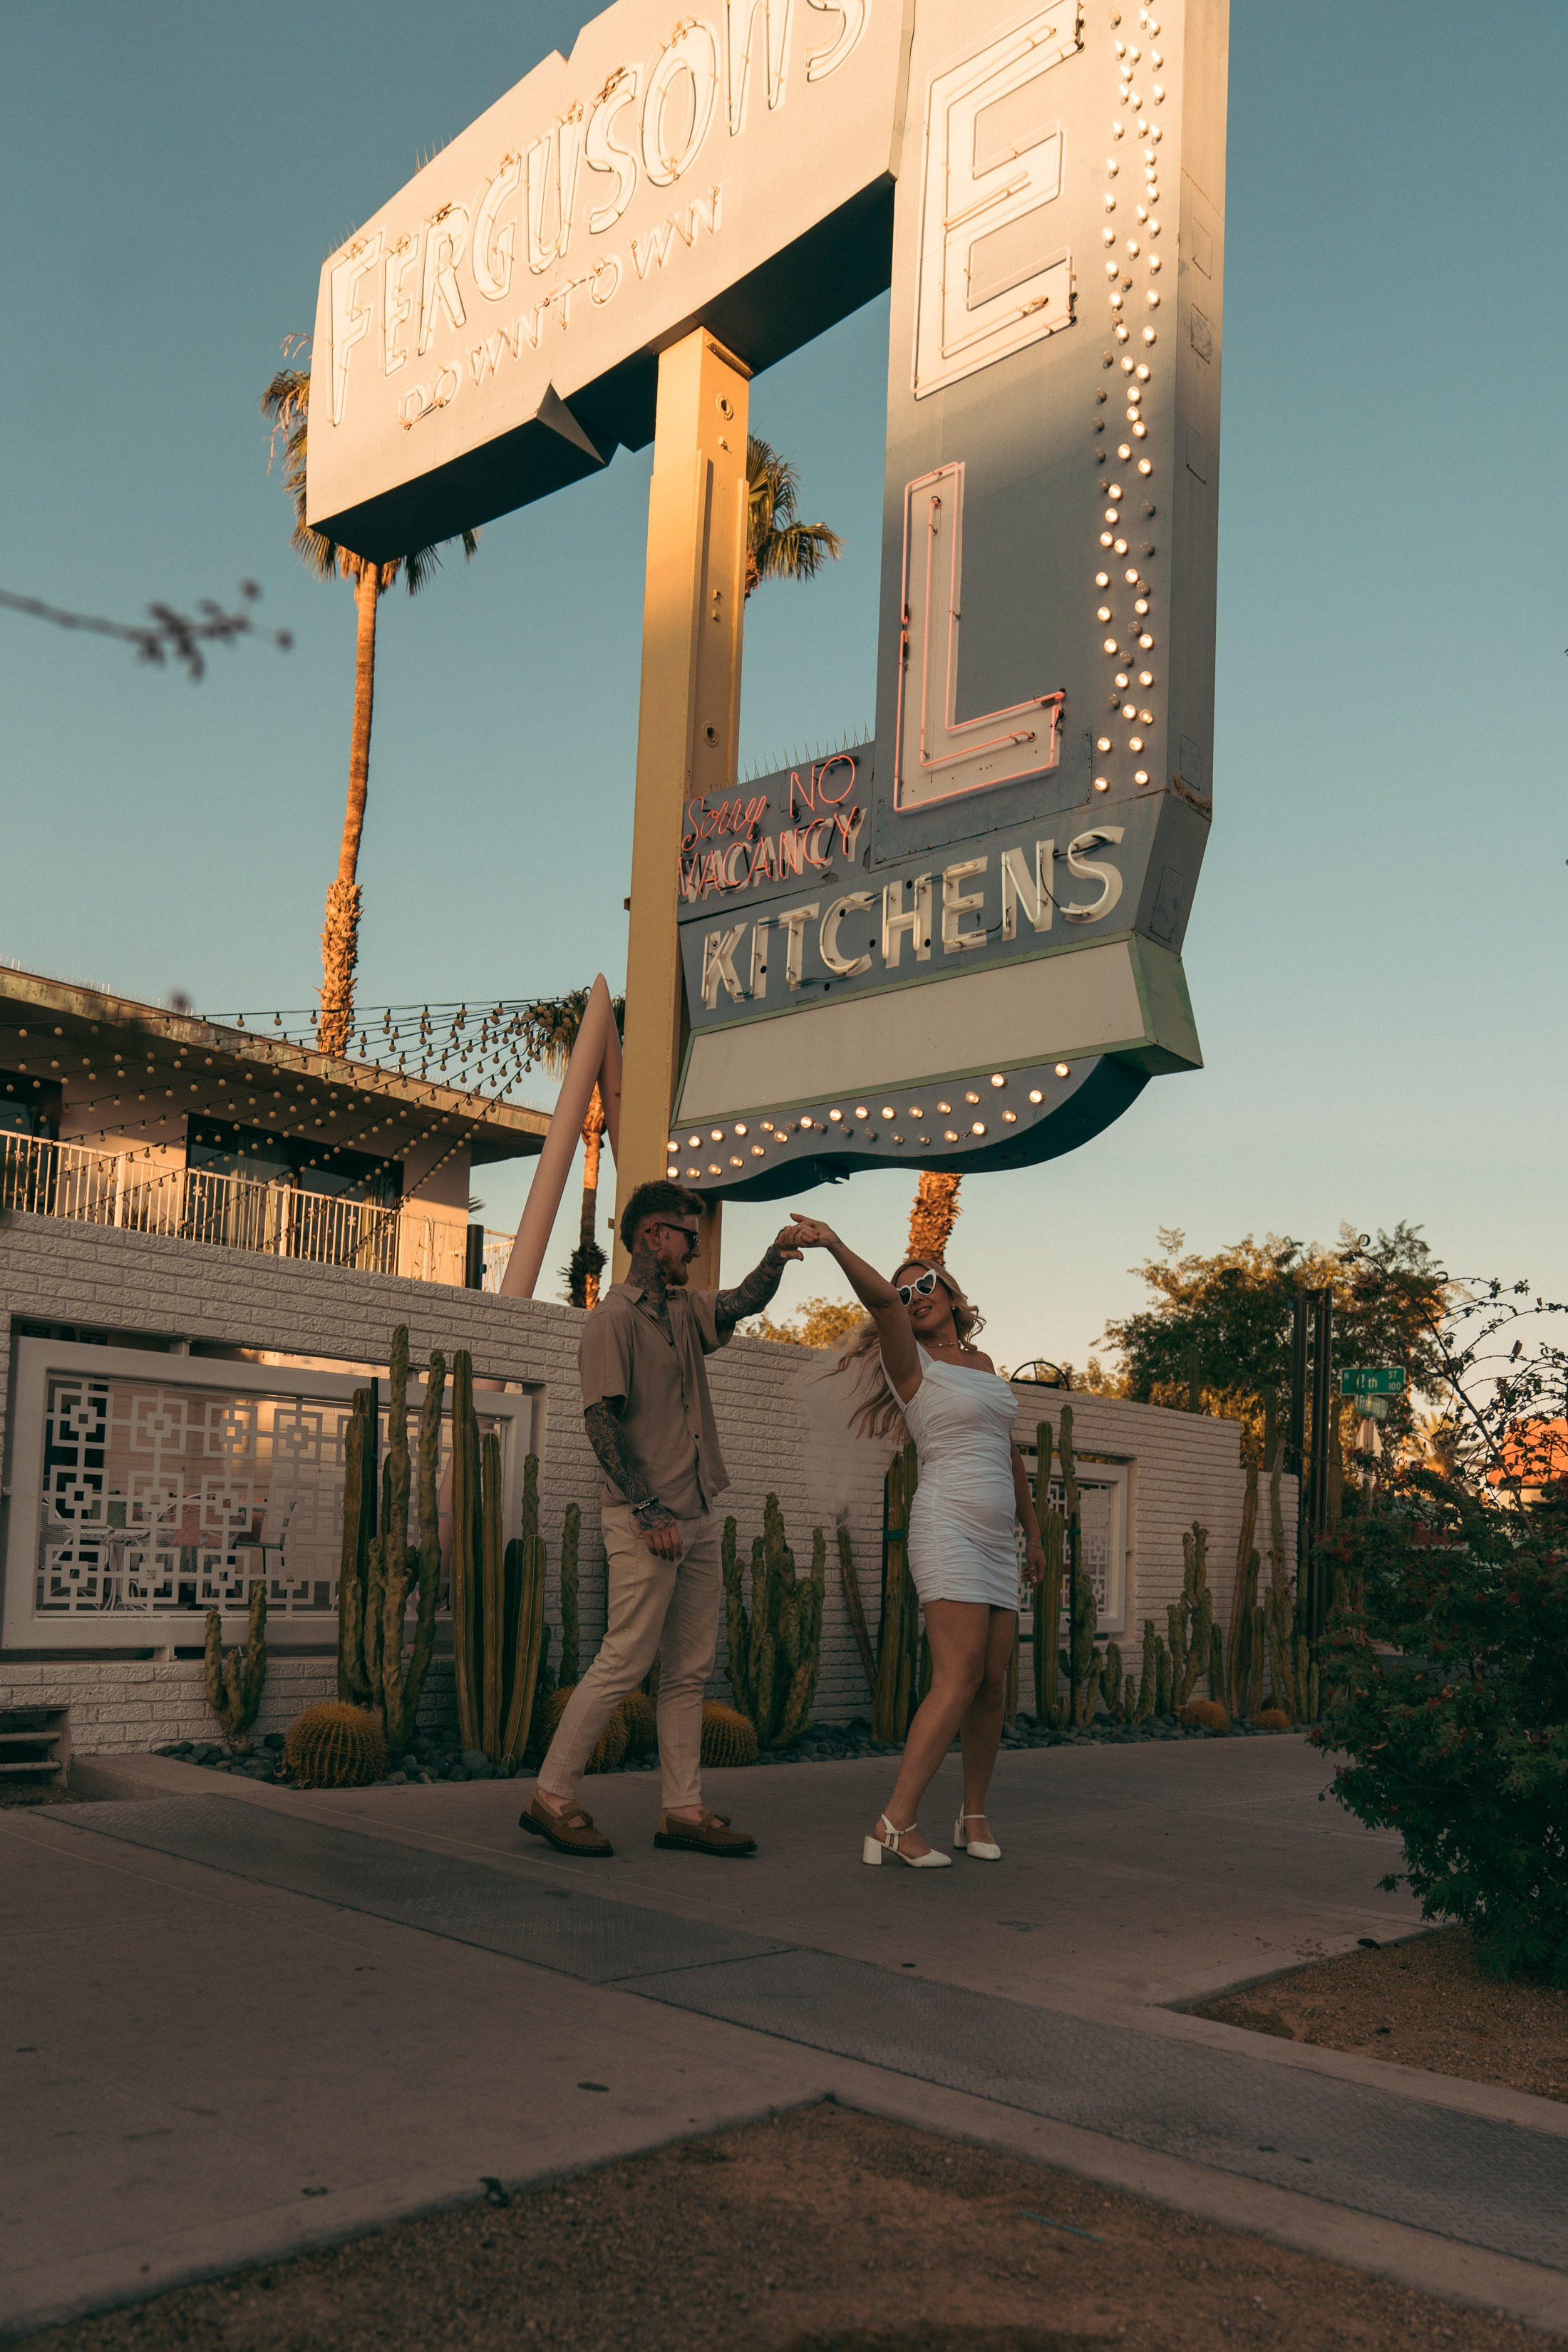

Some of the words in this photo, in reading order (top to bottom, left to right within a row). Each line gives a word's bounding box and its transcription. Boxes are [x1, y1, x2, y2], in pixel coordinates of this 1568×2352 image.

[398, 183, 723, 431] DOWNTOWN
[682, 795, 767, 852] Sorry
[790, 755, 856, 819] NO
[678, 805, 867, 904] VACANCY
[701, 825, 1125, 1010] KITCHENS
[1388, 1371, 1397, 1379] ST
